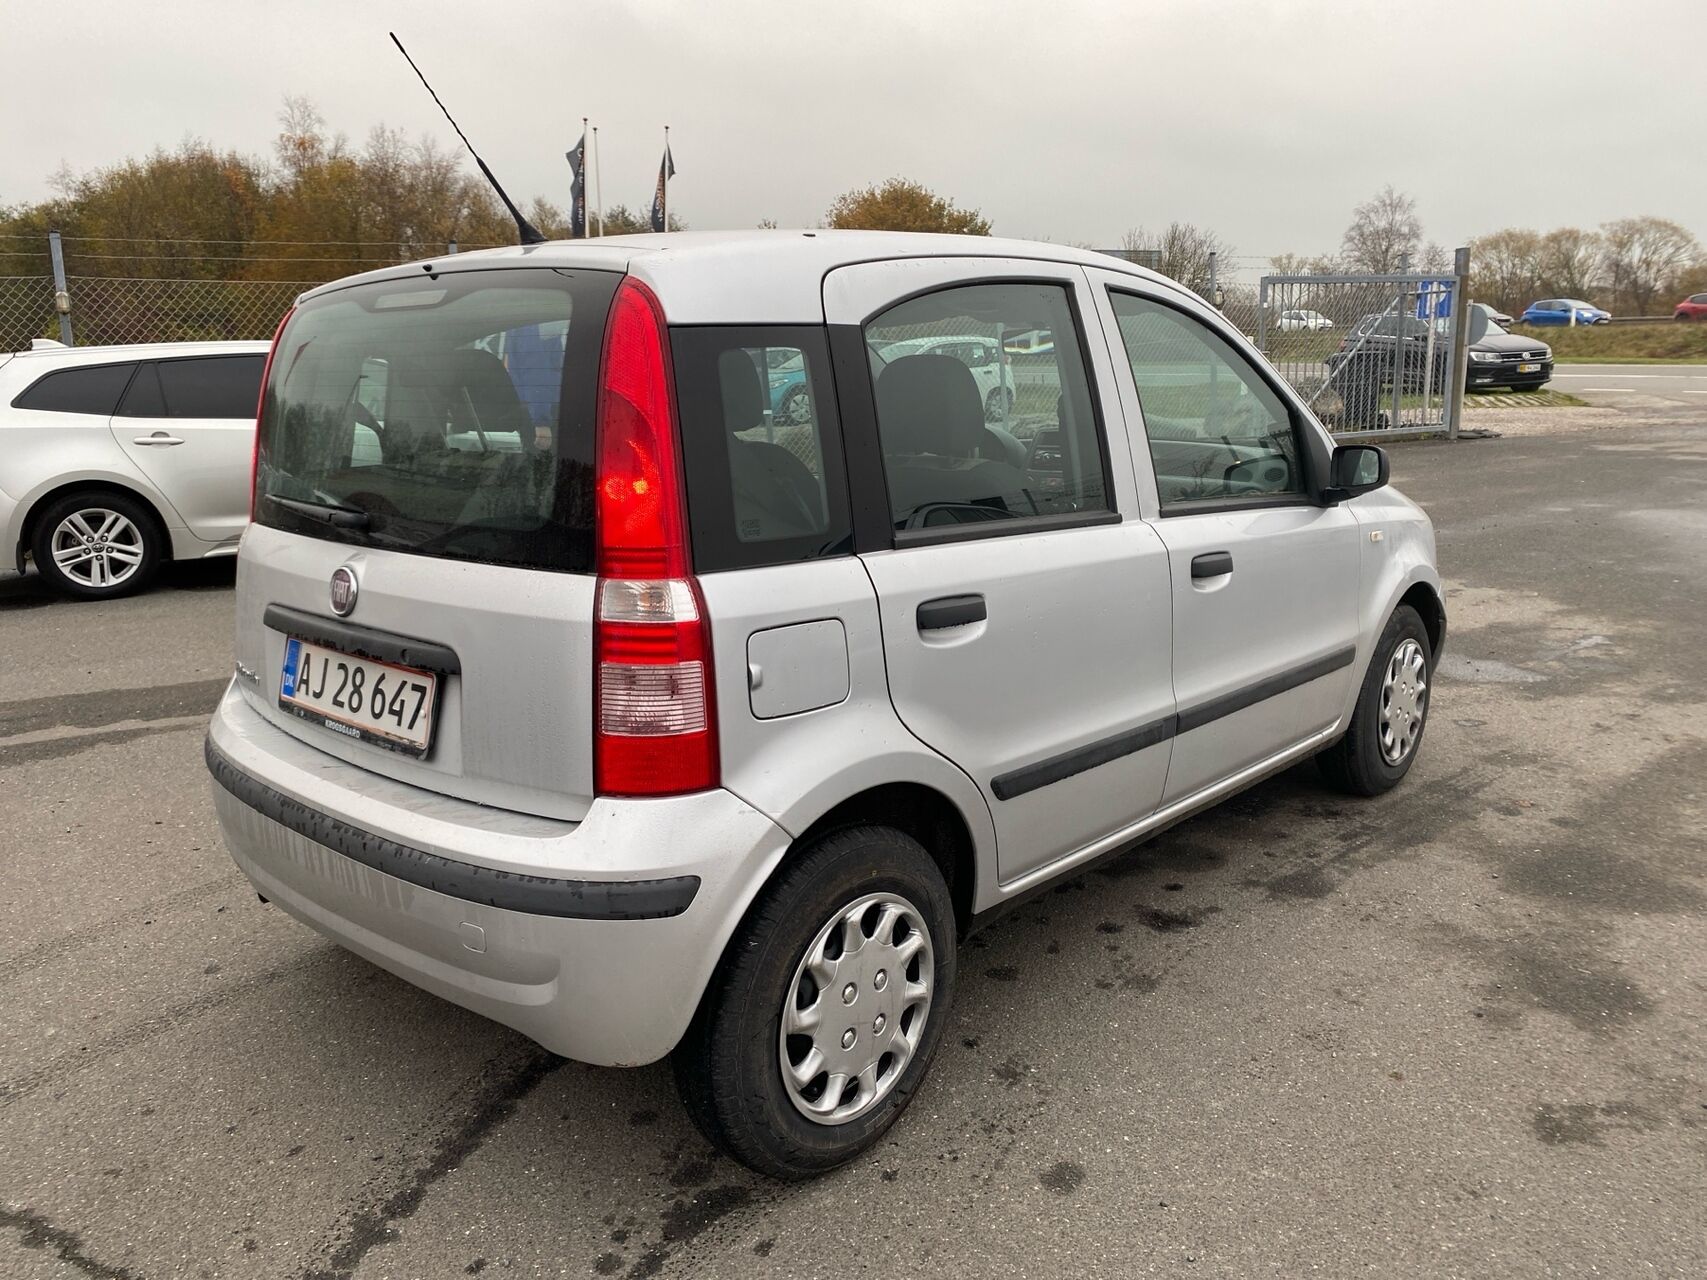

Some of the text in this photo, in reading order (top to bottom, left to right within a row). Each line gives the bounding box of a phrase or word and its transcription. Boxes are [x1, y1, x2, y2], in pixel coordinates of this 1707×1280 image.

[333, 579, 350, 603] FIAT
[285, 674, 294, 687] DK
[297, 652, 329, 699] AJ
[332, 663, 365, 713] 28
[371, 672, 427, 730] 647
